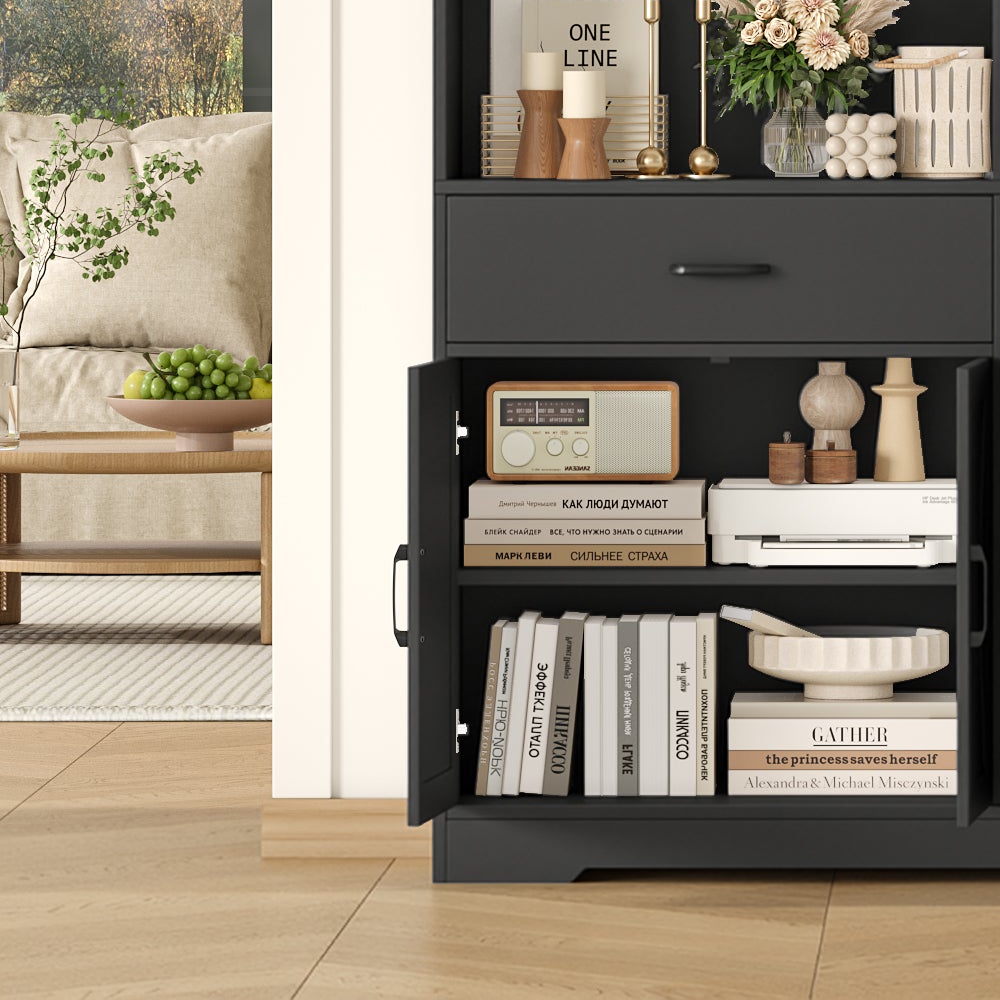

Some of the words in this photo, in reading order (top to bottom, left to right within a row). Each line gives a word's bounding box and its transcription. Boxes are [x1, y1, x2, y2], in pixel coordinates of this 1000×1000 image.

[569, 23, 611, 42] ONE
[564, 49, 617, 67] LINE
[562, 499, 583, 510] КАК
[586, 499, 619, 511] ЛЮДИ
[621, 499, 668, 511] ДУМАЮТ
[484, 527, 507, 536] БЛЕЙК
[509, 527, 542, 537] СНАЙДЕР
[549, 528, 565, 537] ВСЕ,
[644, 529, 684, 537] СЦЕНАРИИ
[495, 552, 523, 560] МАРК
[524, 552, 552, 560] ЛЕВИ
[570, 551, 623, 562] СИЛЬНЕЕ
[628, 551, 669, 562] СТРАХА
[812, 726, 888, 743] GATHER
[766, 754, 789, 765] the
[791, 754, 849, 767] princess
[850, 755, 888, 765] saves
[889, 754, 938, 765] herself
[744, 775, 808, 789] Alexandra
[824, 775, 874, 789] Michael
[879, 775, 949, 792] Misczynski
